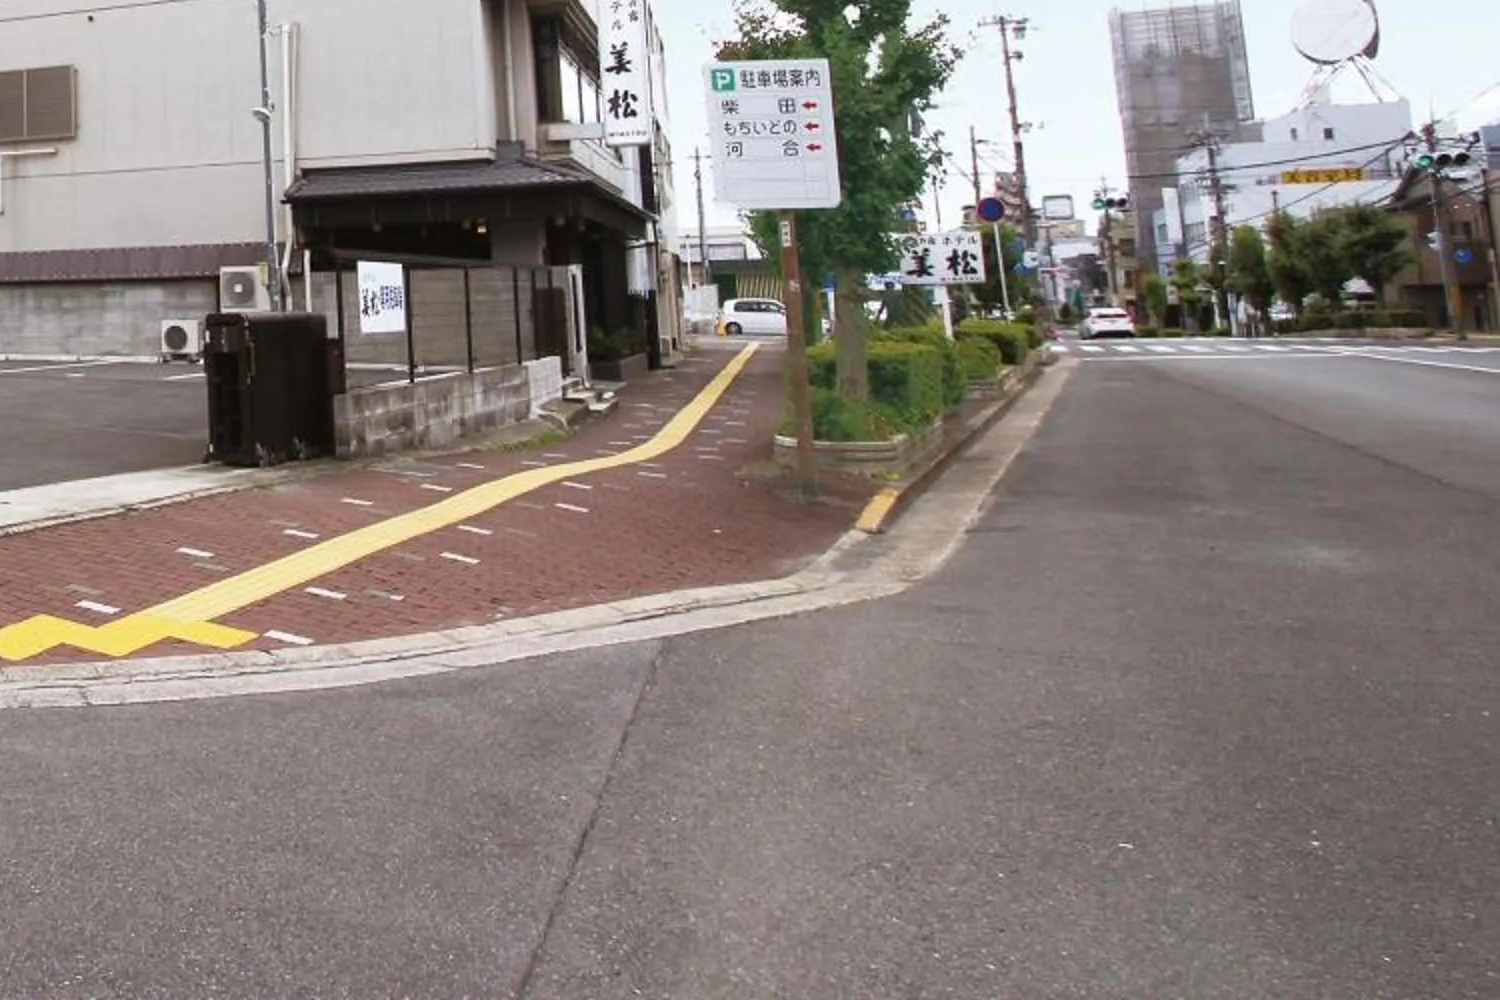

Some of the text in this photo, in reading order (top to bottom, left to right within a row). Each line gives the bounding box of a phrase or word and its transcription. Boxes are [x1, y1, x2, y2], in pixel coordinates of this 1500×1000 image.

[739, 69, 821, 89] 駐車場案内
[724, 119, 797, 135] もちいどの
[906, 247, 978, 277] 美松
